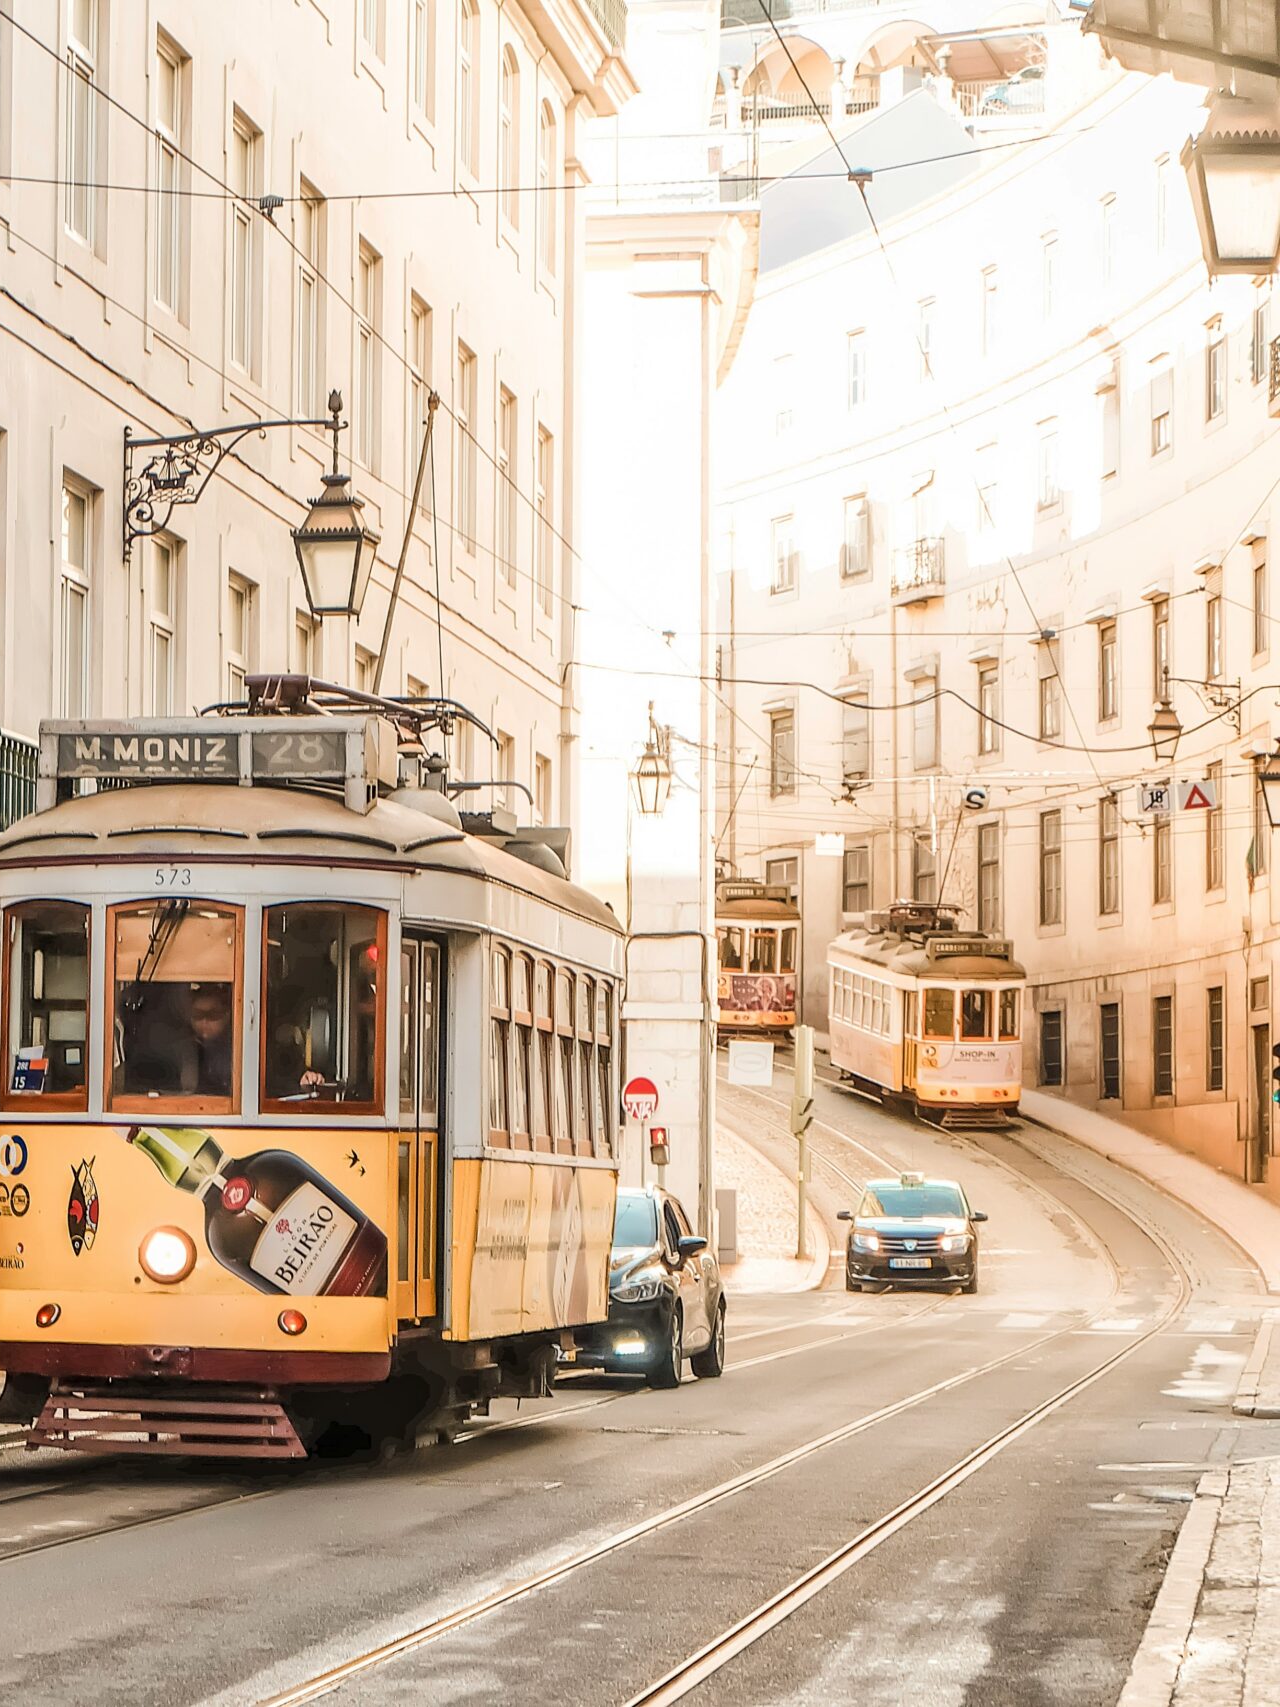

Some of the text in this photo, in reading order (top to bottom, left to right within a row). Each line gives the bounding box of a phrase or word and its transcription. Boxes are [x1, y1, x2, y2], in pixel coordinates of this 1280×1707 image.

[270, 733, 325, 765] 28
[964, 790, 986, 810] S
[155, 868, 191, 886] 573
[959, 1051, 996, 1059] SHOP-IN
[14, 1076, 26, 1089] 15
[274, 1205, 334, 1285] BEIRÃO
